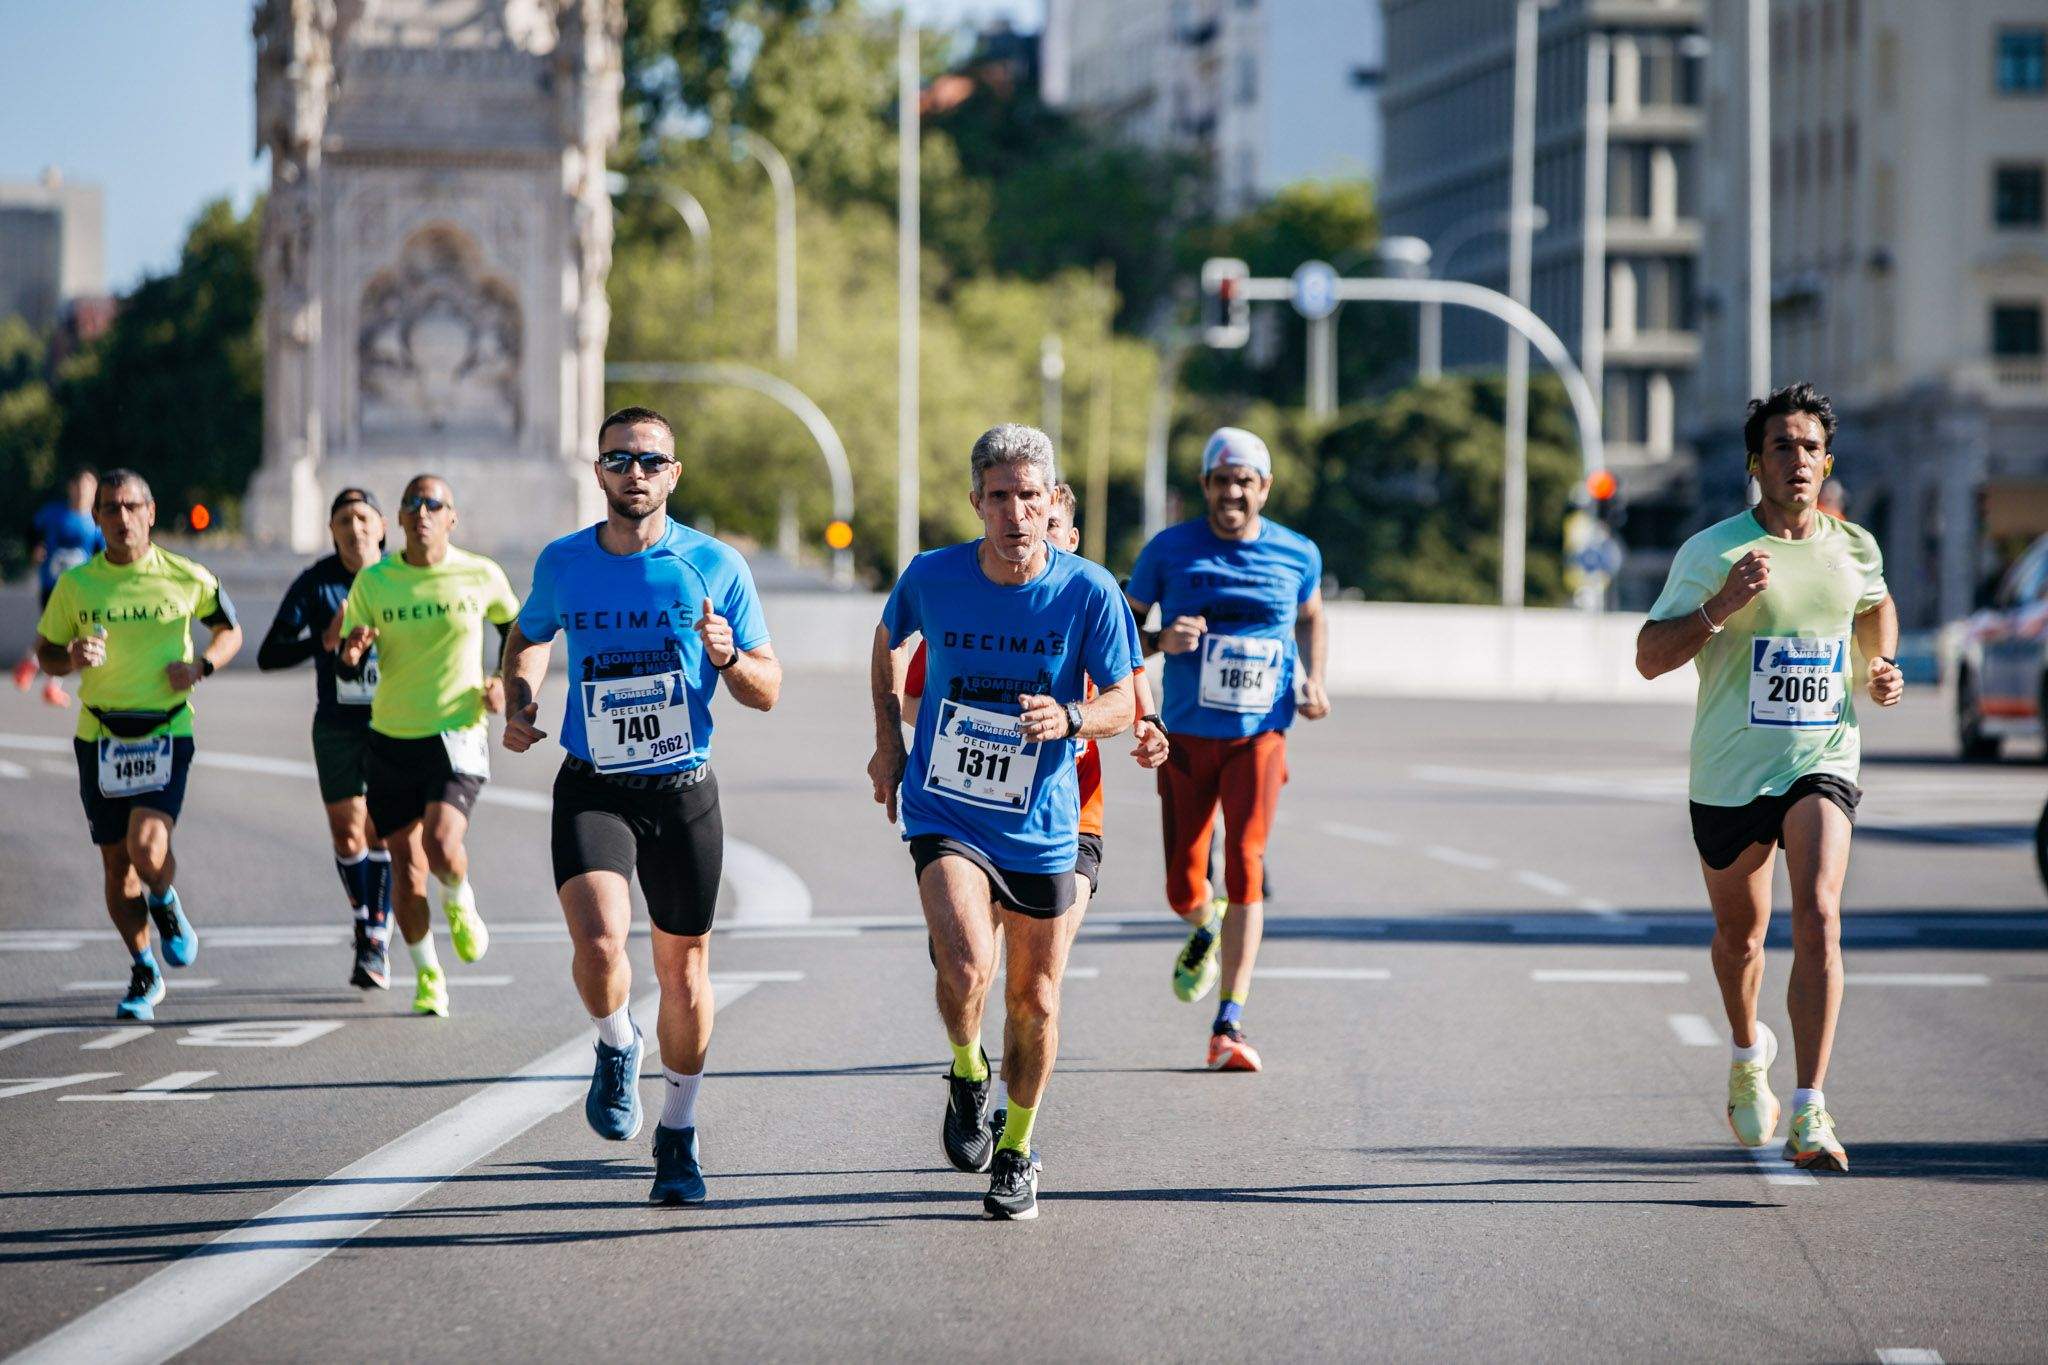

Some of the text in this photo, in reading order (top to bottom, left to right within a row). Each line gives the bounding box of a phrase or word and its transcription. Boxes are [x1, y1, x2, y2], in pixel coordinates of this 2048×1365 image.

[79, 602, 179, 624] DECIMAS
[382, 601, 479, 623] DECIMAS
[944, 631, 1066, 656] DECIMAS
[1220, 667, 1264, 690] 1864
[1781, 666, 1829, 674] DECIMAS
[614, 687, 664, 701] BOMBEROS
[1768, 675, 1829, 703] 2066
[611, 703, 666, 716] DECIMAS
[612, 714, 661, 745] 740
[971, 723, 1021, 739] BOMBEROS
[650, 735, 683, 758] 2662
[963, 736, 1018, 755] DECIMAS
[114, 759, 156, 780] 1495
[957, 747, 1011, 783] 1311
